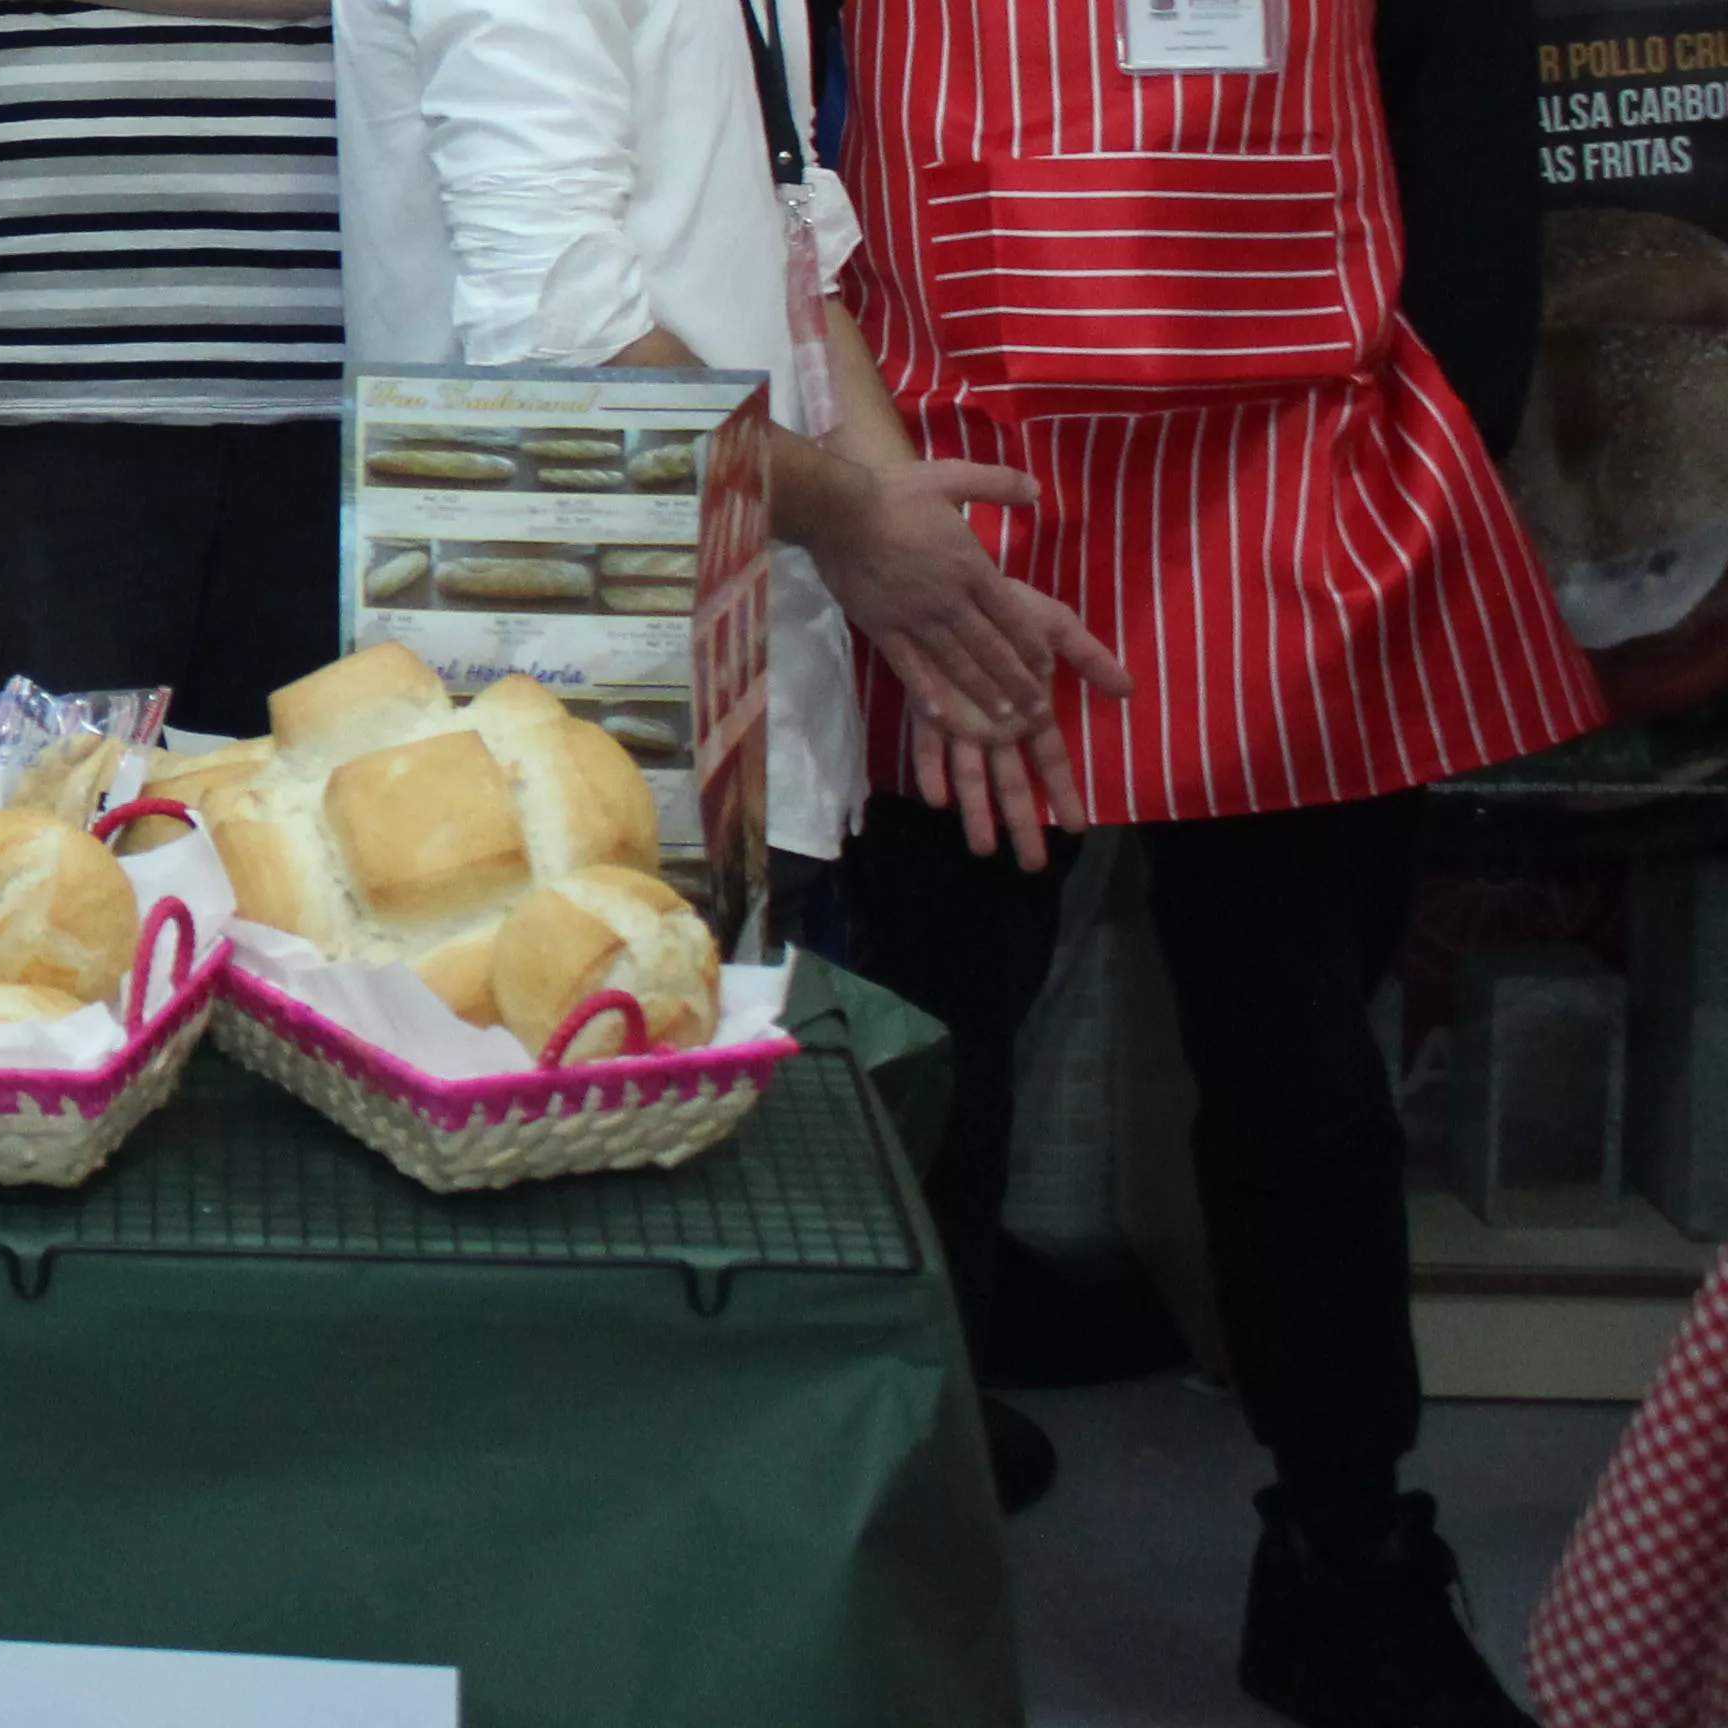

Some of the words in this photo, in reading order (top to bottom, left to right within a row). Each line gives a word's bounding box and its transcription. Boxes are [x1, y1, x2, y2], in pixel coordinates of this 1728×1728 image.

[1569, 34, 1667, 80] POLLO
[1619, 82, 1728, 127] CARBO
[1583, 136, 1693, 181] FRITAS
